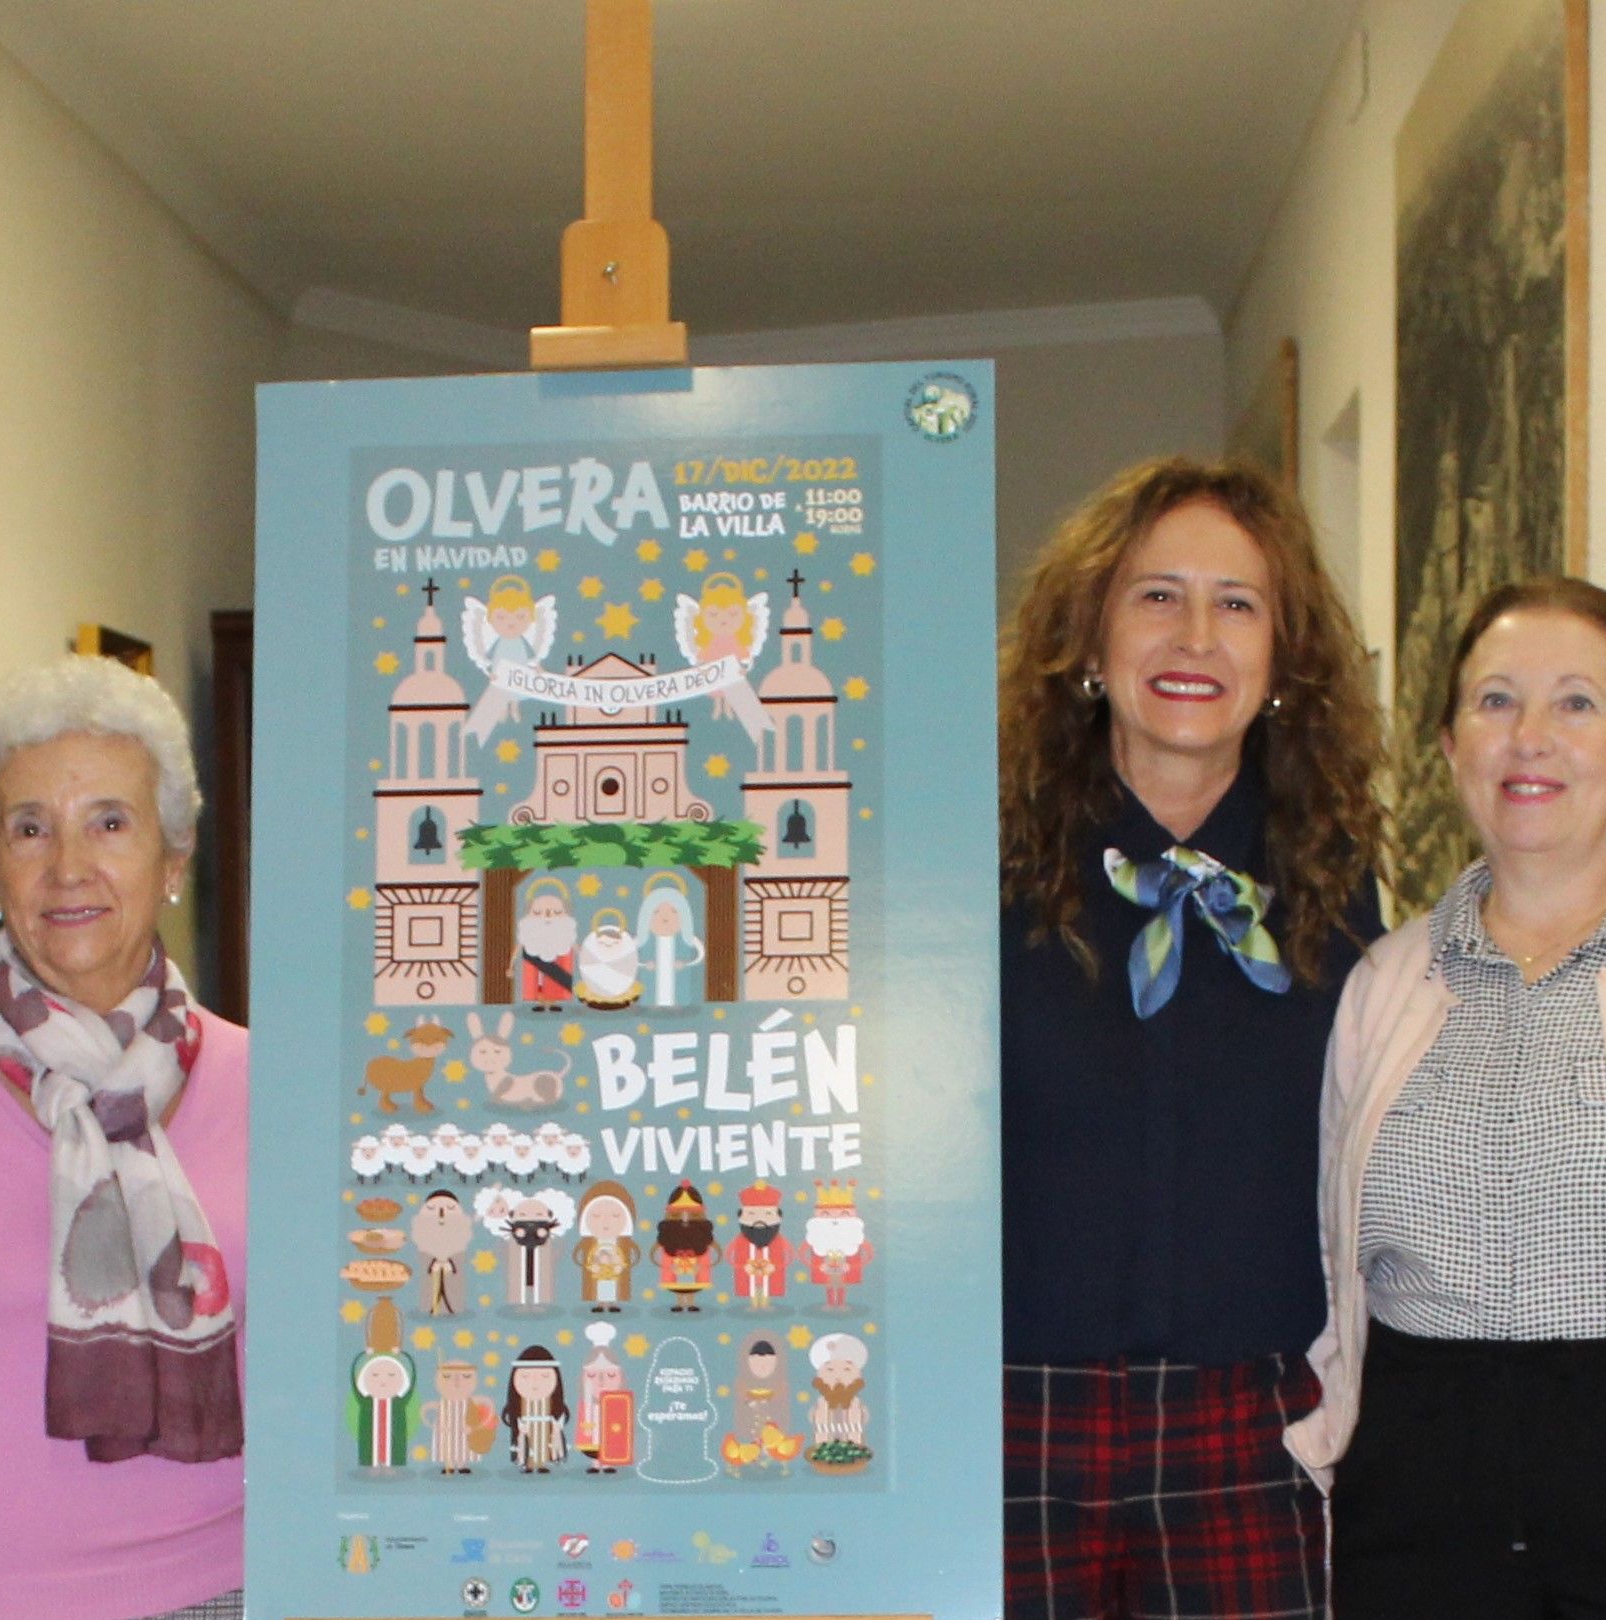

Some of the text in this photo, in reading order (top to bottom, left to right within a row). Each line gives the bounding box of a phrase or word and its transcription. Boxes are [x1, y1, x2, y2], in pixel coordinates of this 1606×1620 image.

[674, 455, 859, 485] 17/DIC/2022
[366, 457, 671, 546] OLVERA
[679, 491, 787, 514] BARRIO DE
[805, 488, 863, 505] 11:00
[679, 512, 786, 539] LA VILLA
[805, 507, 864, 529] 19:00
[373, 544, 529, 572] EN NAVIDAD
[584, 684, 604, 702] IN
[609, 678, 678, 704] OLVERA
[684, 661, 725, 688] DEO!
[592, 1007, 860, 1115] BELÉN
[600, 1120, 862, 1178] VIVIENTE
